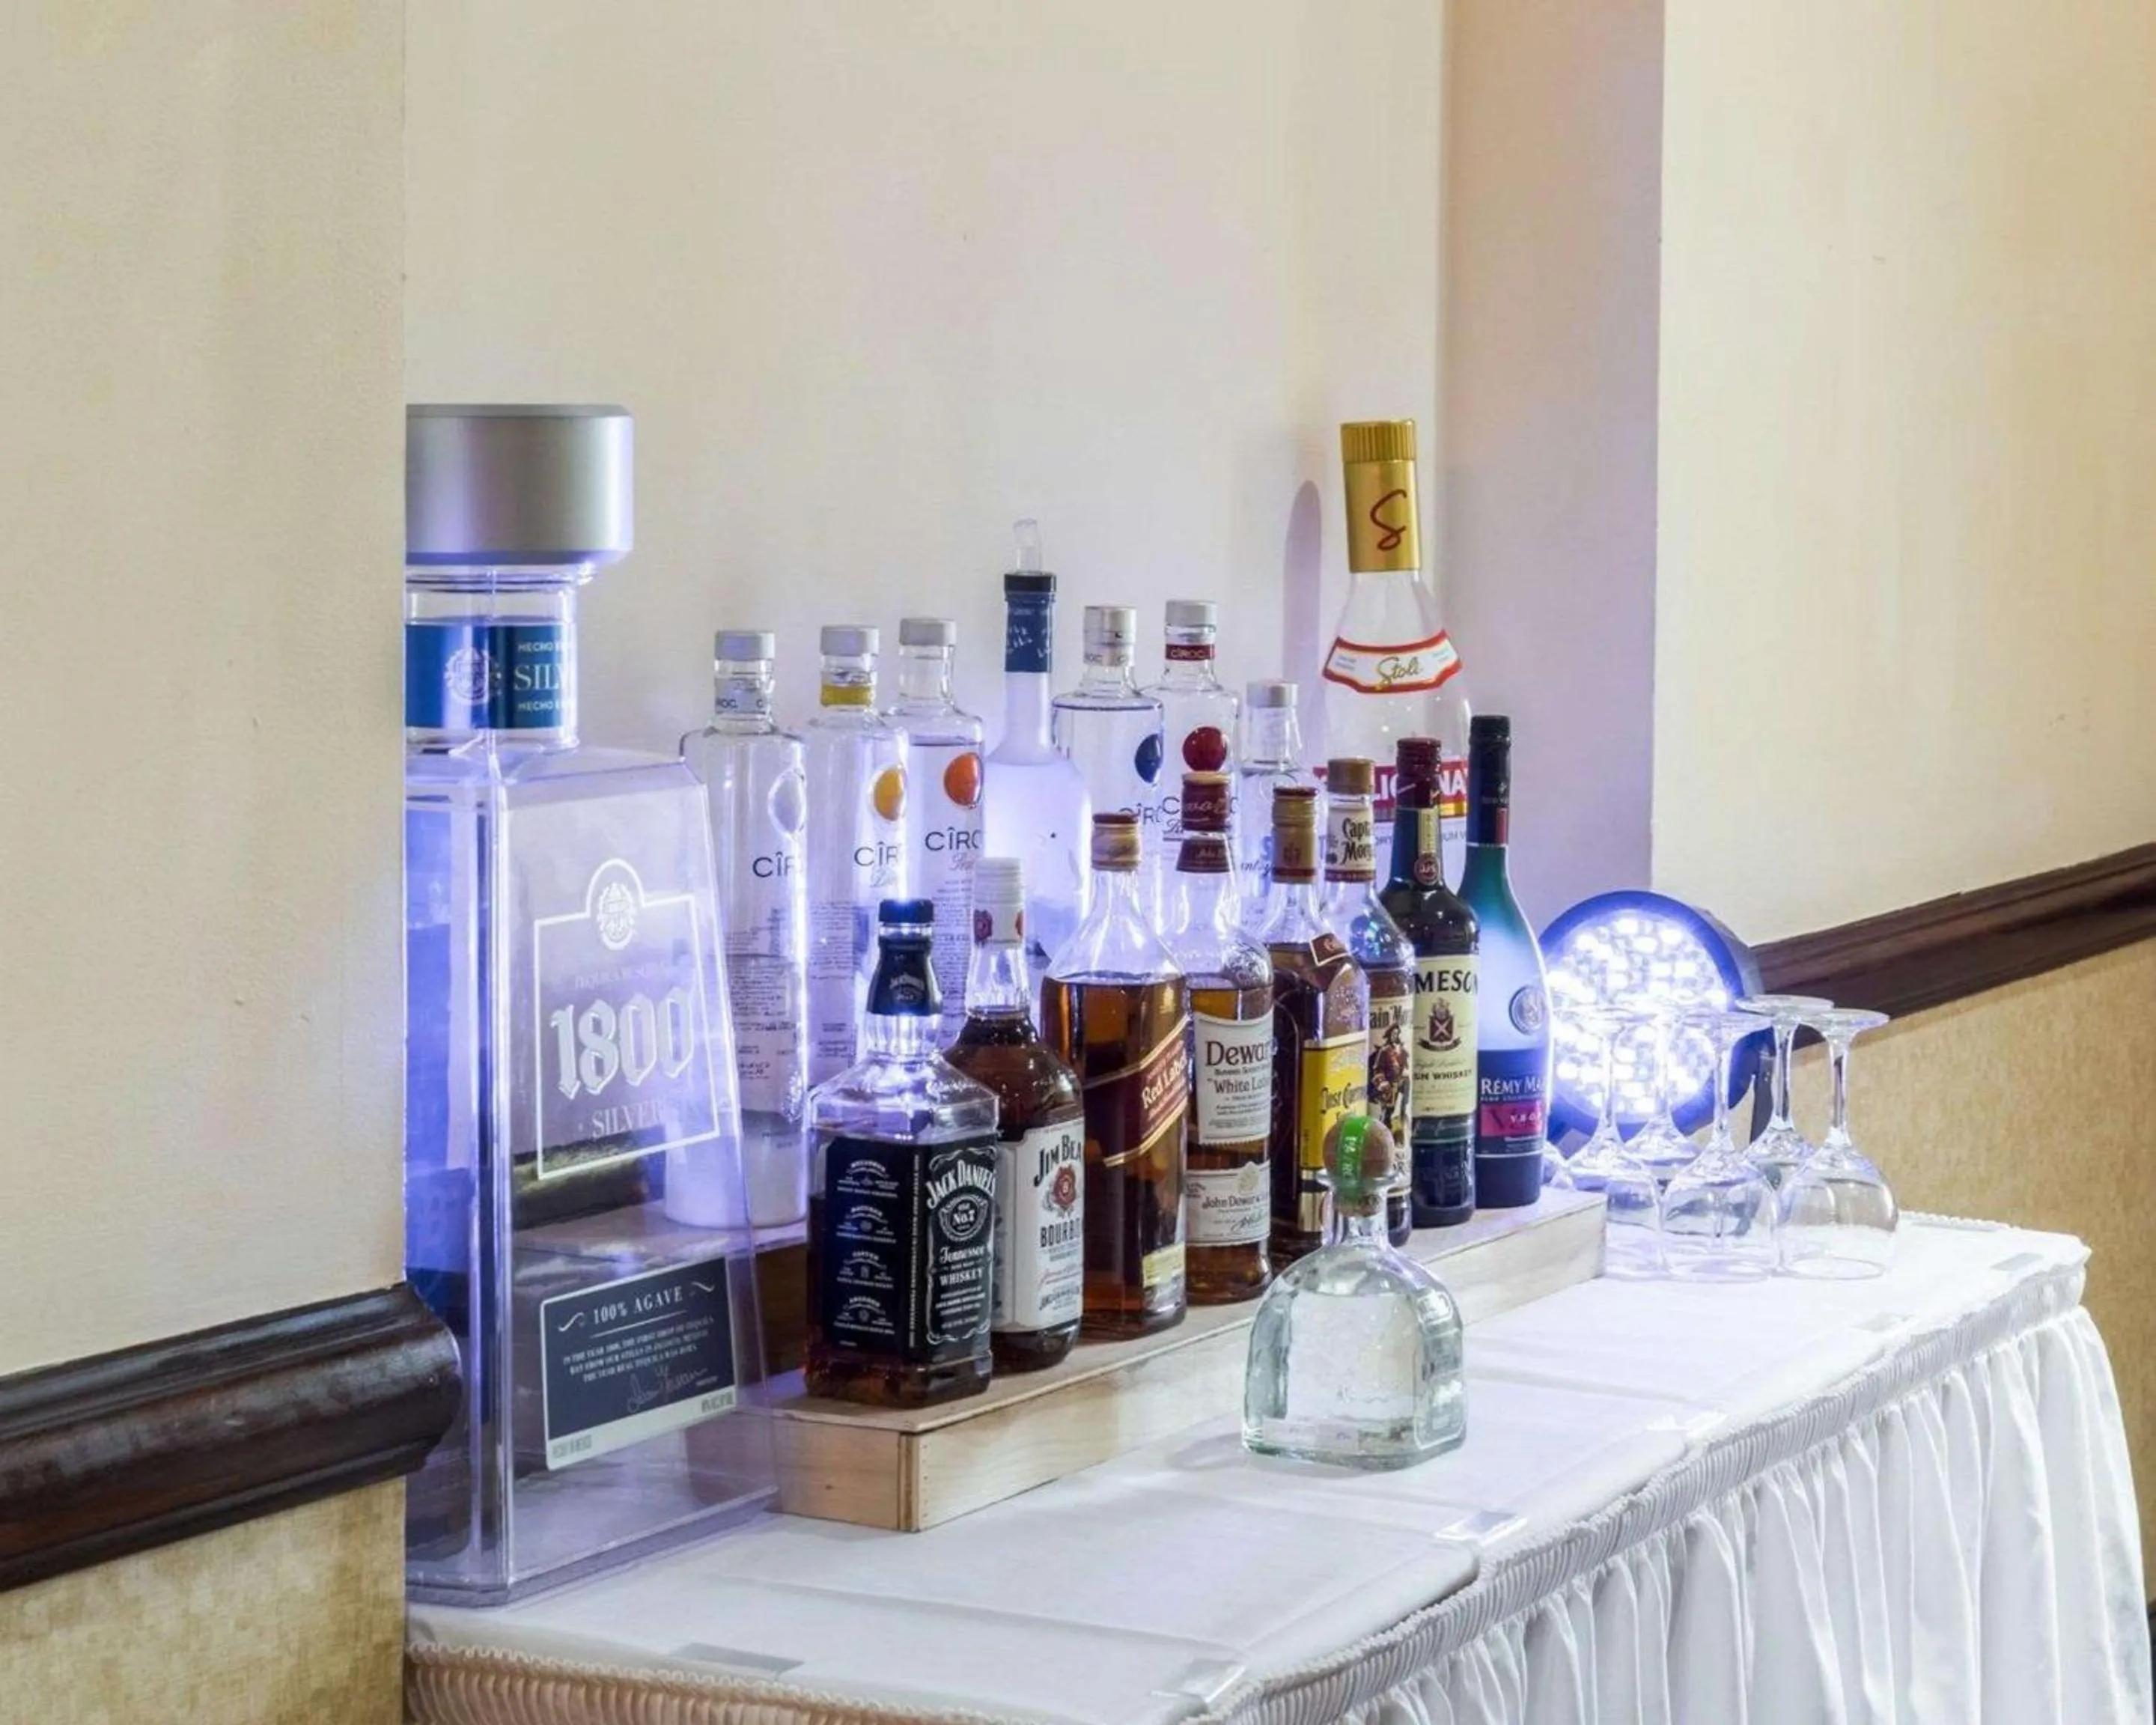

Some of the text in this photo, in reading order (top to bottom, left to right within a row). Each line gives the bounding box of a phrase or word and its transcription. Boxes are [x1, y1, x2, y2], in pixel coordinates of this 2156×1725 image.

[550, 988, 694, 1099] 1800
[1033, 1145, 1061, 1187] JIM
[925, 1169, 957, 1210] JACK
[939, 1266, 984, 1286] WHISKEY
[594, 1285, 683, 1325] 100% AGAVE
